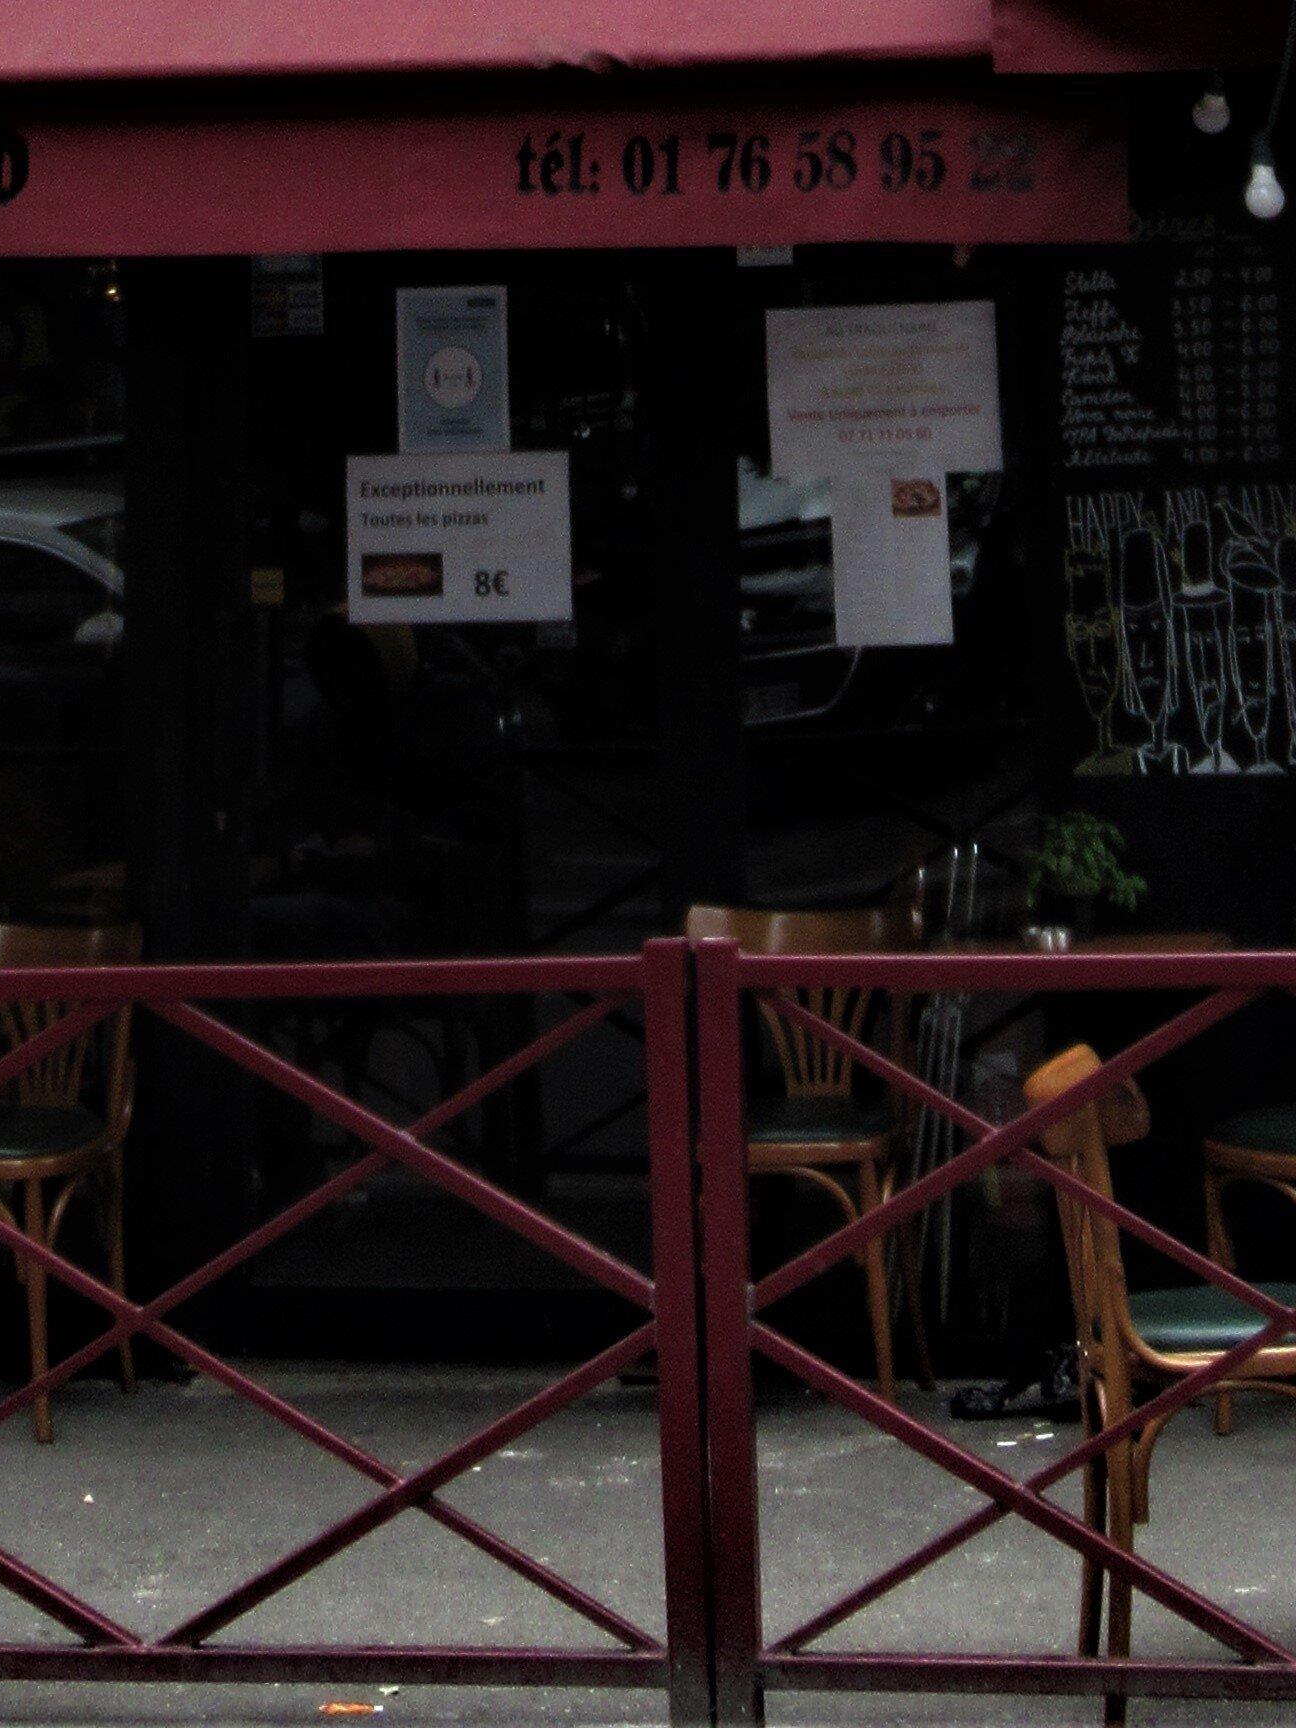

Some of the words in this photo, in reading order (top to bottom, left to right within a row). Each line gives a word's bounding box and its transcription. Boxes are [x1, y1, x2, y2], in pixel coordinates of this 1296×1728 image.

[514, 129, 602, 199] tél:
[622, 134, 685, 199] 01
[706, 132, 774, 197] 76
[792, 130, 860, 196] 58
[878, 130, 949, 196] 95
[360, 478, 546, 500] Exceptionnellement
[473, 570, 511, 597] 8€
